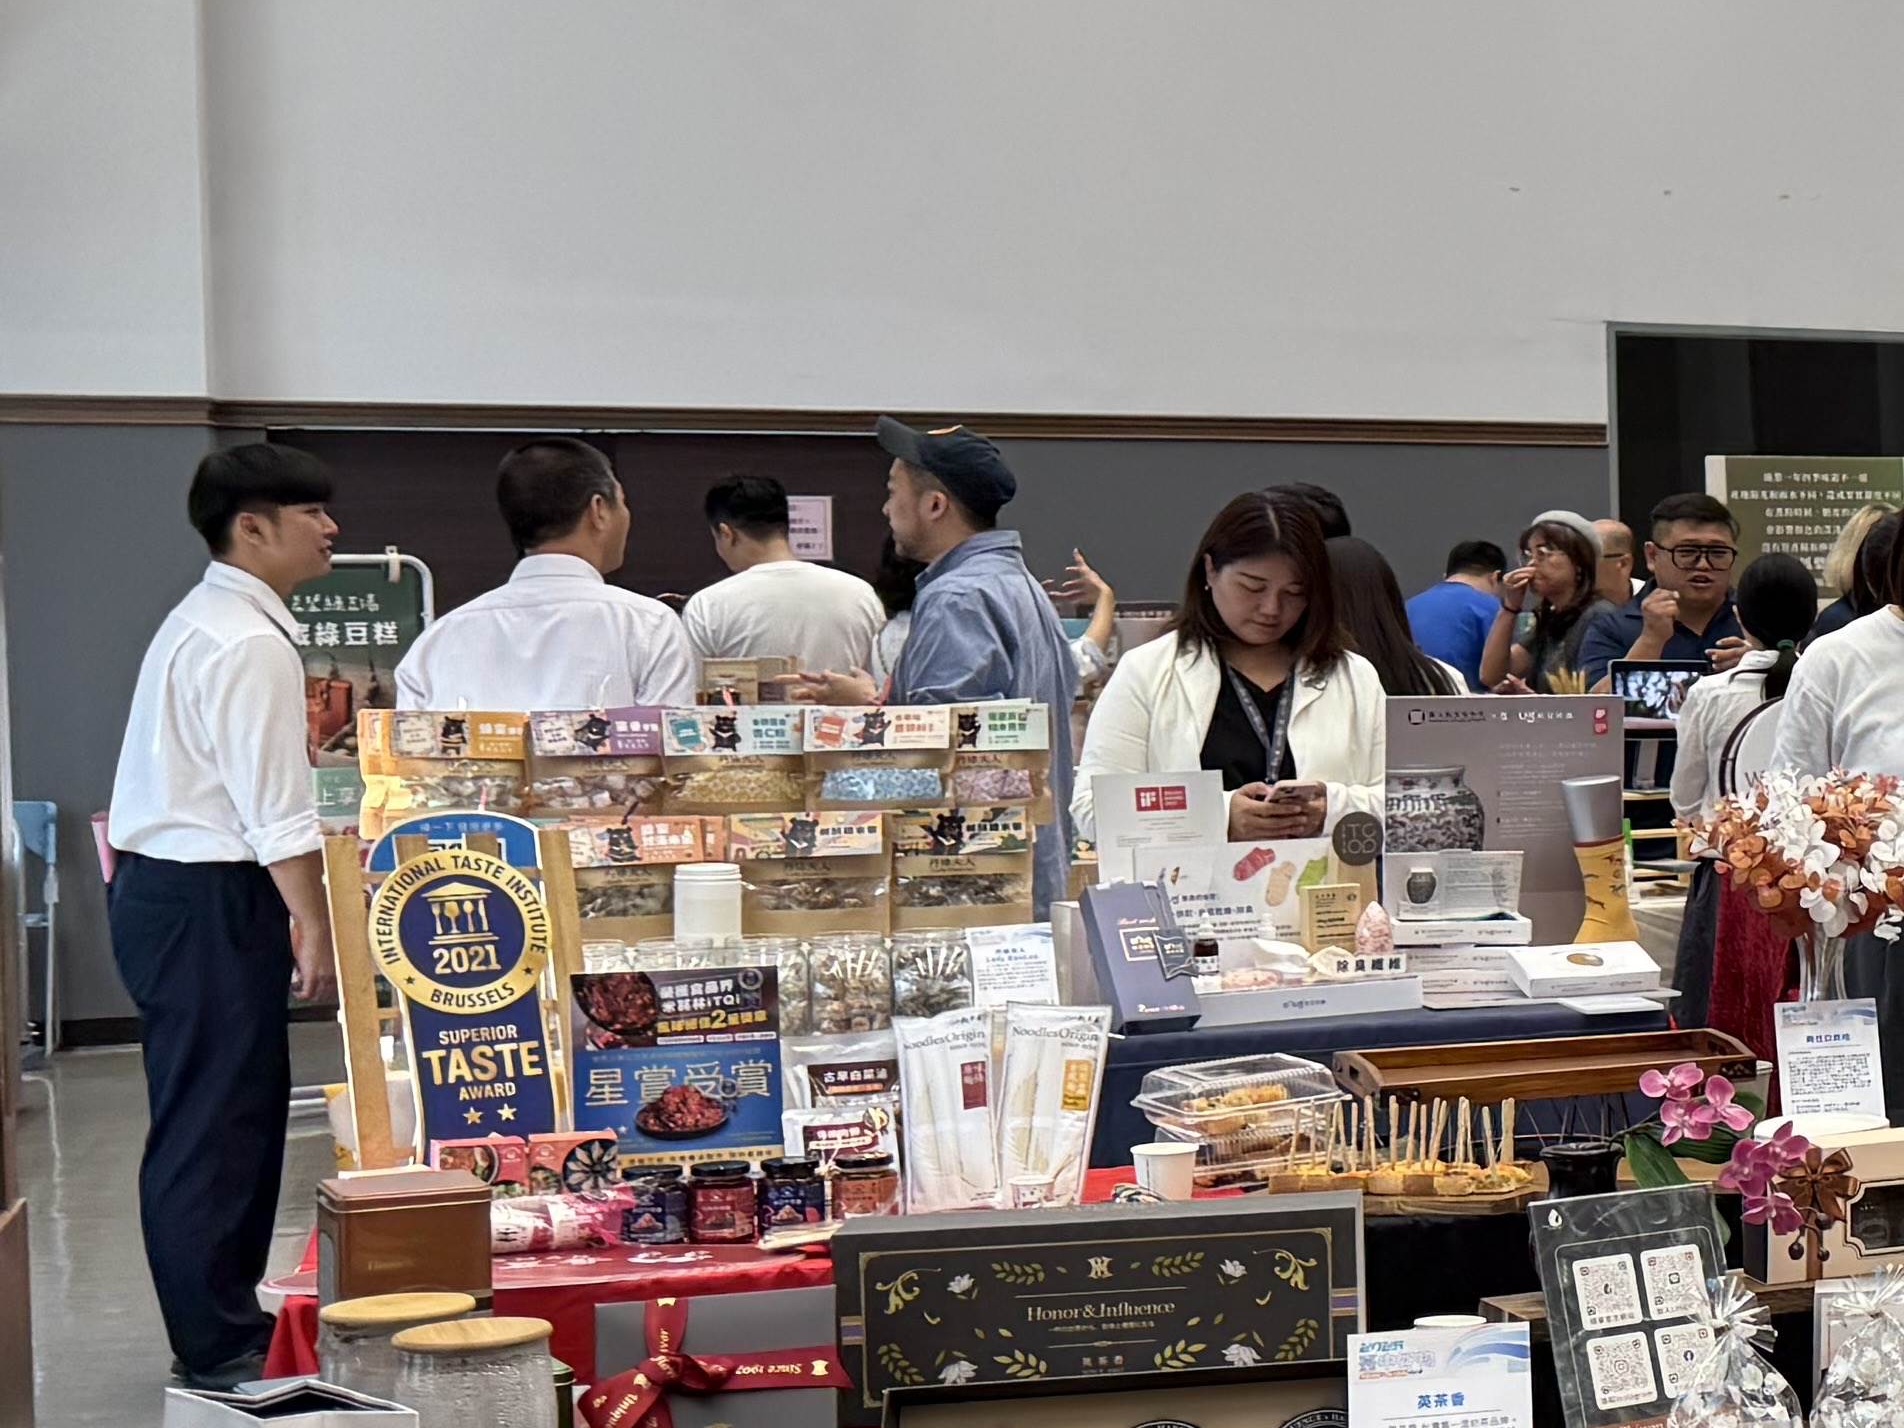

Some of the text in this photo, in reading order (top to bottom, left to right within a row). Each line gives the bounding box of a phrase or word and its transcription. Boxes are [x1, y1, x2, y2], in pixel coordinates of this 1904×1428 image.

[377, 856, 548, 965] INTERNATIONAL TASTE INSTITUTE
[432, 943, 503, 975] 2021
[430, 981, 516, 1006] BRUSSELS
[438, 1024, 518, 1046] SUPERIOR
[421, 1040, 544, 1086] TASTE
[459, 1081, 516, 1101] AWARD
[585, 1058, 773, 1107] 星賞受賞
[1027, 1300, 1176, 1322] Honor&Influence
[1417, 1392, 1465, 1409] 英茶香
